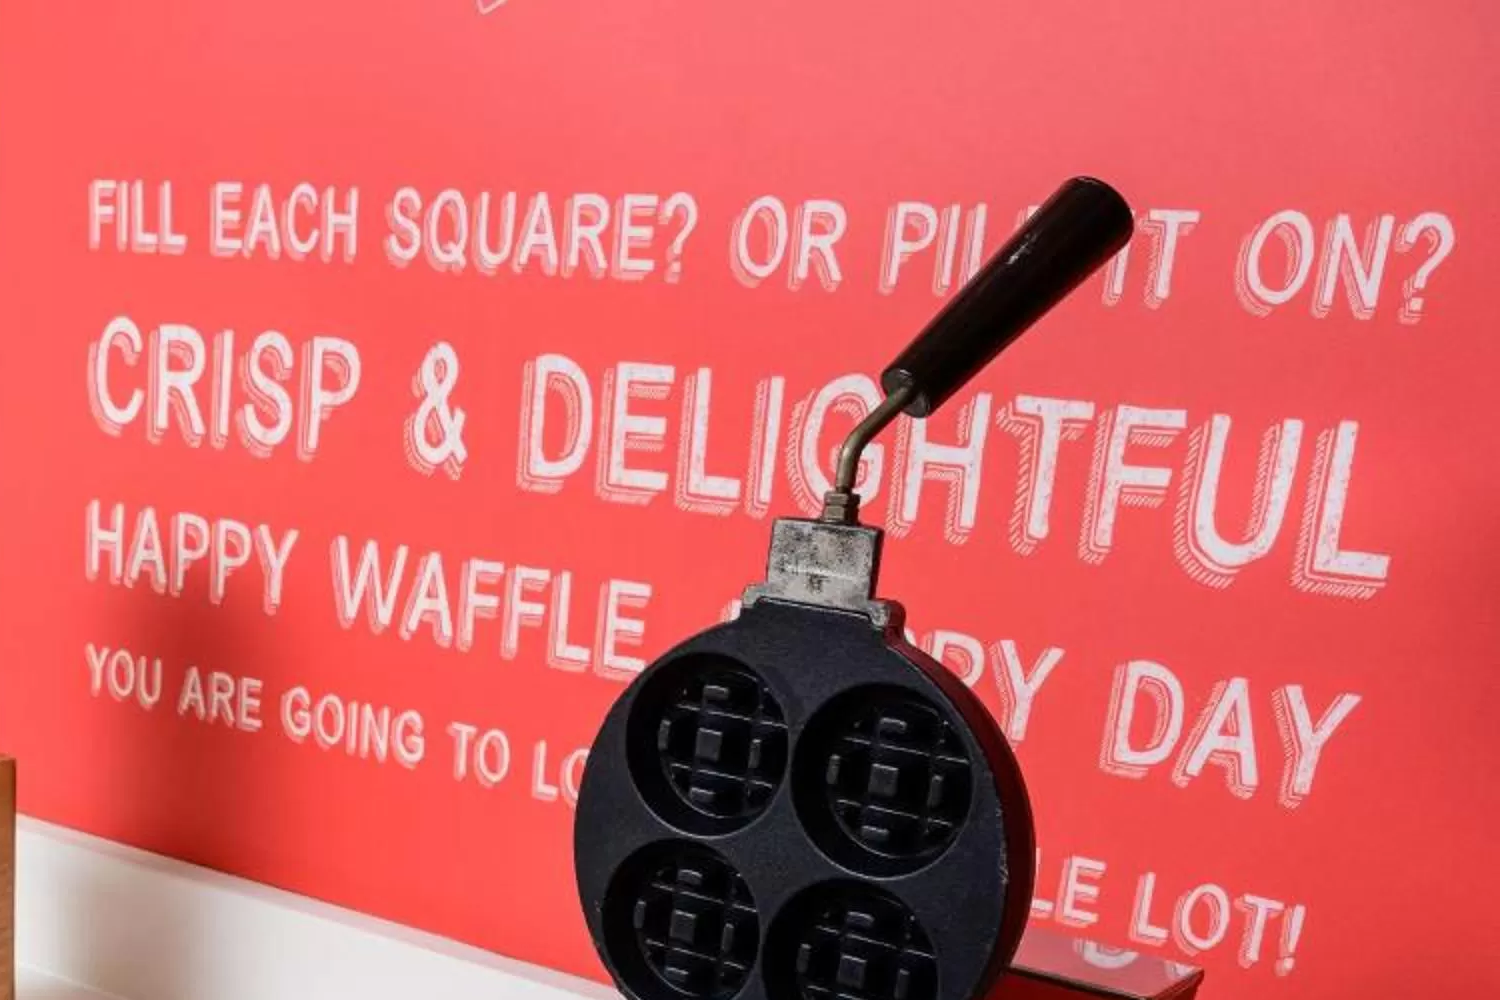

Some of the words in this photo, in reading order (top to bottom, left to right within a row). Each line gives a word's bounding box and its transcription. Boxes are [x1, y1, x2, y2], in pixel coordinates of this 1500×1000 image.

[88, 178, 187, 255] FILL
[210, 182, 360, 264] EACH
[385, 186, 699, 284] SQUARE?
[729, 194, 847, 290] OR
[878, 201, 1042, 296] PIL
[1236, 208, 1457, 325] ON?
[87, 315, 363, 464] CRISP
[404, 341, 468, 481] &
[516, 353, 1393, 601] DELIGHTFUL
[85, 498, 299, 616] HAPPY
[331, 534, 654, 682] WAFFLE
[1100, 659, 1363, 812] DAY
[85, 643, 163, 711] YOU
[178, 665, 263, 734] ARE
[281, 686, 426, 770] GOING
[446, 721, 510, 789] TO
[1129, 871, 1307, 978] LOT!
